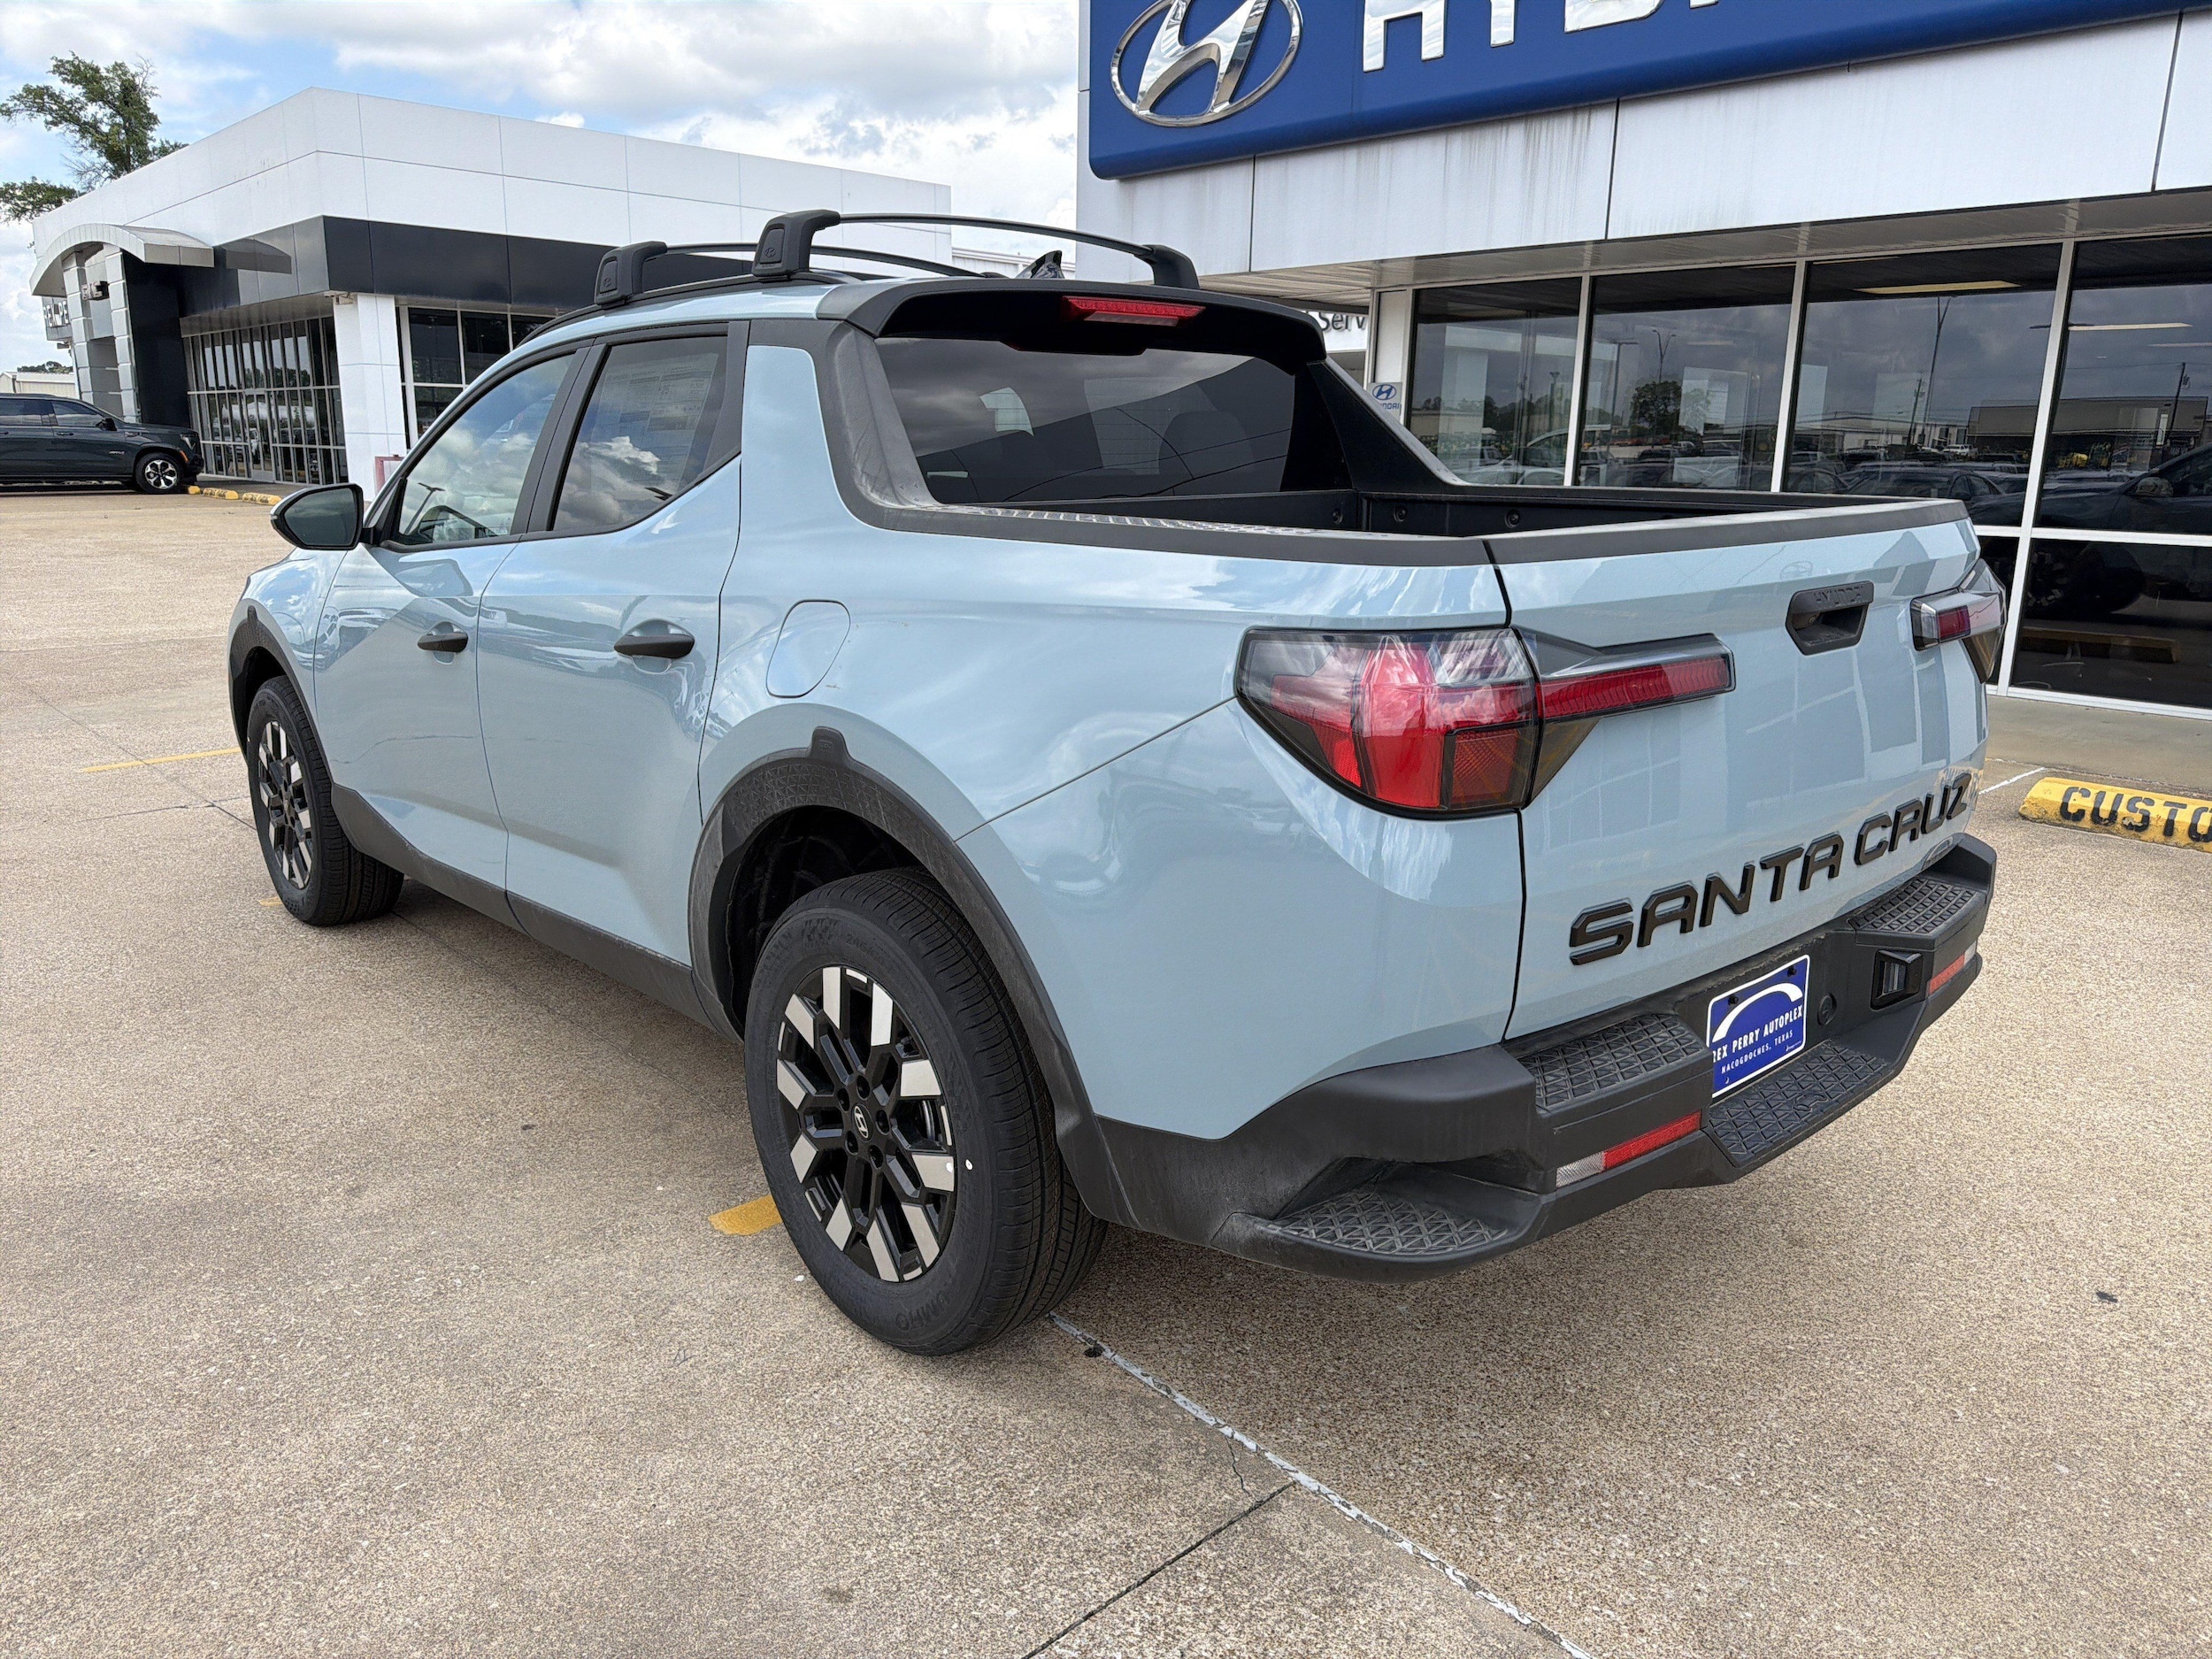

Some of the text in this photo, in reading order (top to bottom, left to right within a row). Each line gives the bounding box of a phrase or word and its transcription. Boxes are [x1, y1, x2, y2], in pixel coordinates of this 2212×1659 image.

[1569, 772, 1971, 965] SANTA CRUZ
[1732, 1028, 1760, 1054] PERRY
[1763, 1004, 1803, 1037] AUTOPLEX
[1774, 1030, 1793, 1047] TEXAS
